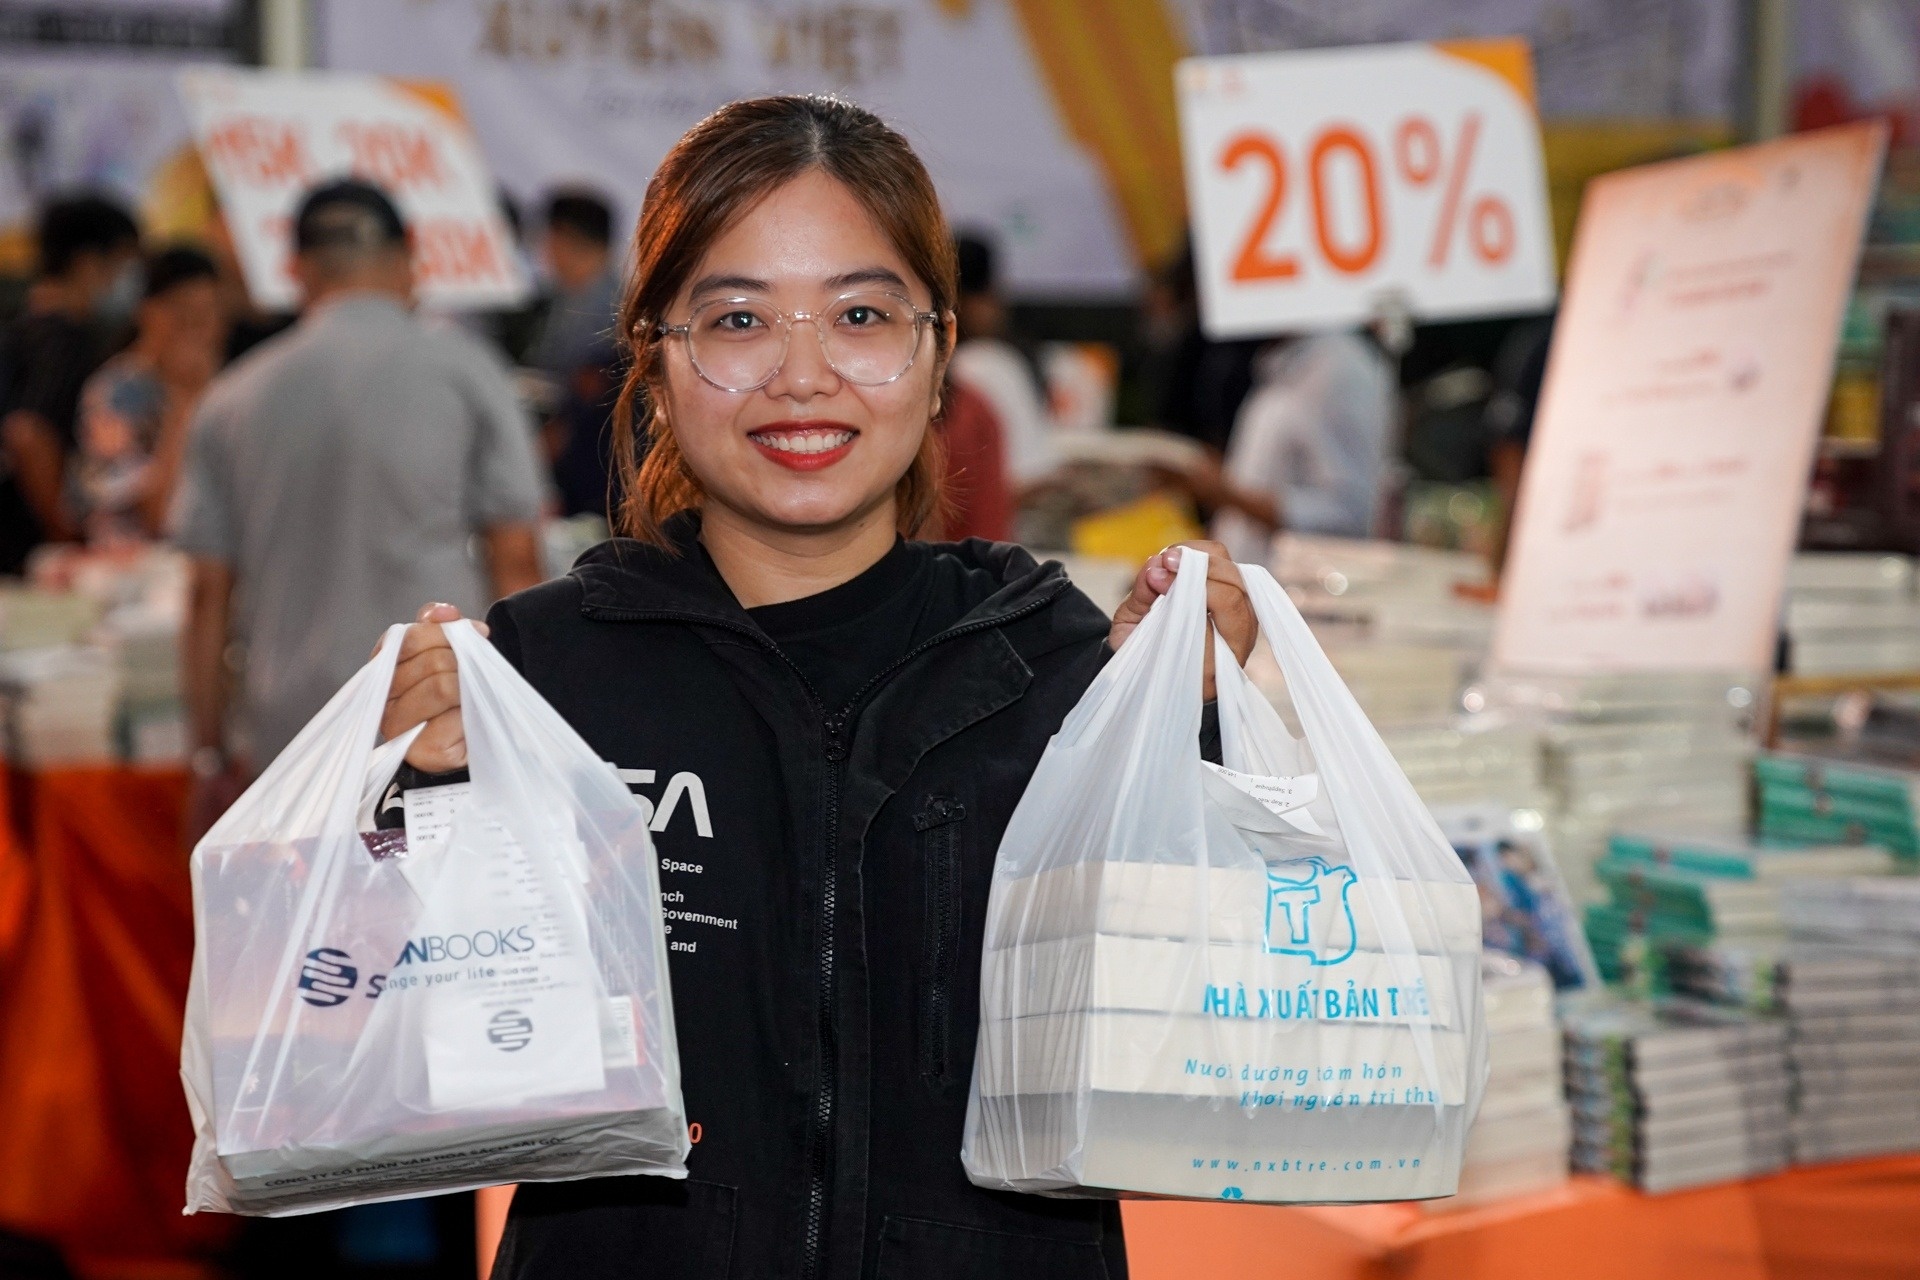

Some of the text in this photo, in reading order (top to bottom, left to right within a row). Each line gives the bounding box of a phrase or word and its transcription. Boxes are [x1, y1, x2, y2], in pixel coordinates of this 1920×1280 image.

[1215, 112, 1516, 282] 20%
[661, 858, 704, 874] Space
[670, 941, 697, 953] and
[425, 970, 460, 987] your
[467, 966, 496, 981] life
[1325, 979, 1380, 1018] BẢN
[1192, 1157, 1421, 1173] www.nxbtre.com.vn
